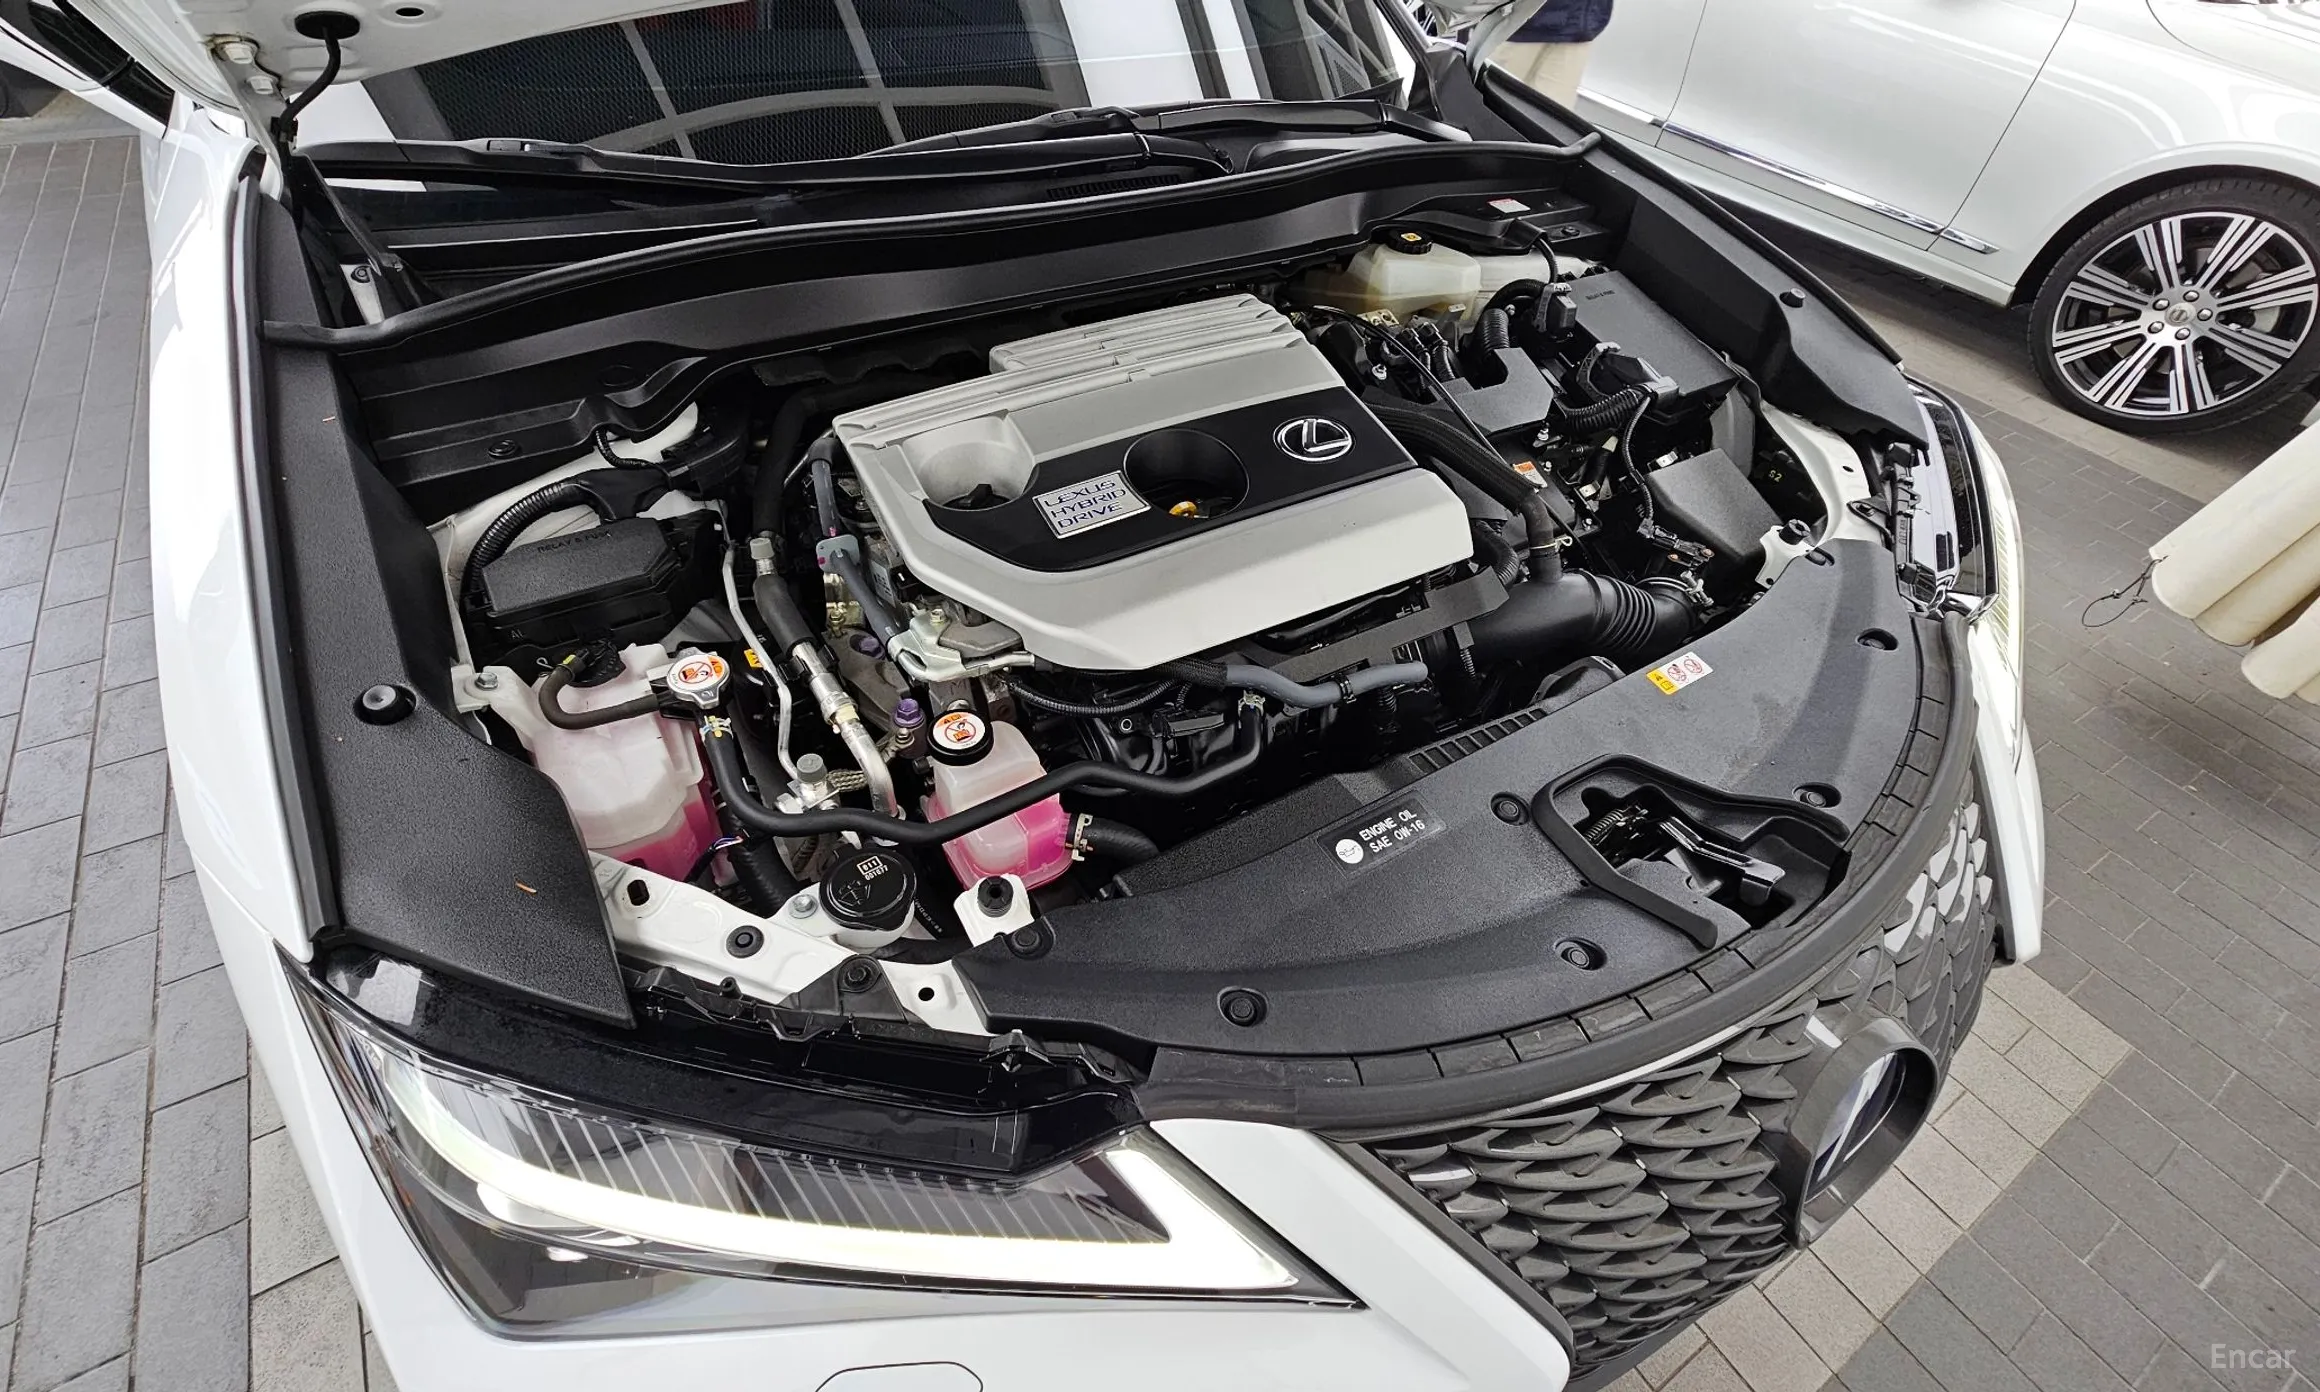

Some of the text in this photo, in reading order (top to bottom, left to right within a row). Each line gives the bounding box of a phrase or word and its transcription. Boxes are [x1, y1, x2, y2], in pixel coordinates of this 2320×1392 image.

[1044, 480, 1116, 507] LEXUS
[1051, 489, 1126, 518] HYBRID
[1057, 502, 1122, 528] DRIVE
[1359, 809, 1417, 841] ENGINE OIL
[1369, 819, 1426, 853] SAE 0W-16
